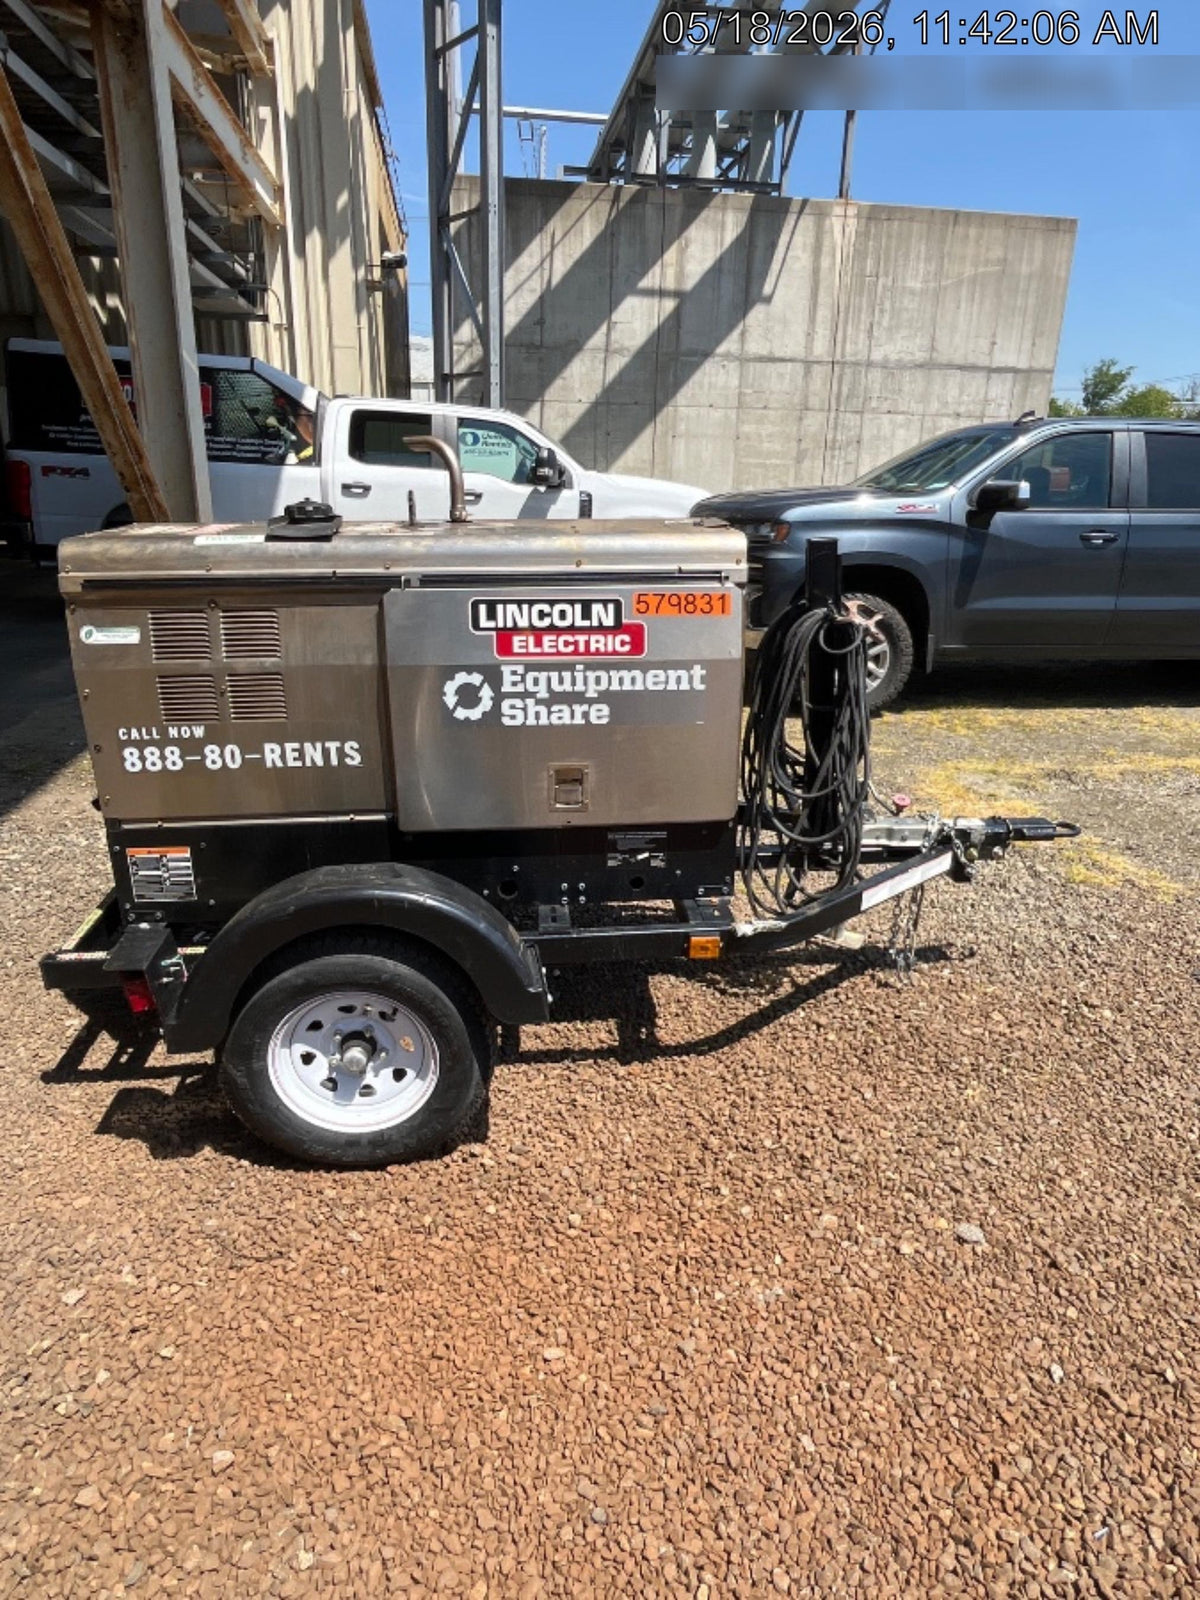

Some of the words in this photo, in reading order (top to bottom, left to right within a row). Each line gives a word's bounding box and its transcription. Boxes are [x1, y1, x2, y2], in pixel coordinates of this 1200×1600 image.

[478, 603, 615, 628] LINCOLN
[635, 593, 728, 615] 579831
[512, 634, 632, 654] ELECTRIC
[500, 664, 707, 699] Equipment
[500, 698, 611, 727] Share
[118, 727, 161, 740] CALL
[168, 725, 206, 739] NOW
[122, 741, 363, 772] 888-80-RENTS
